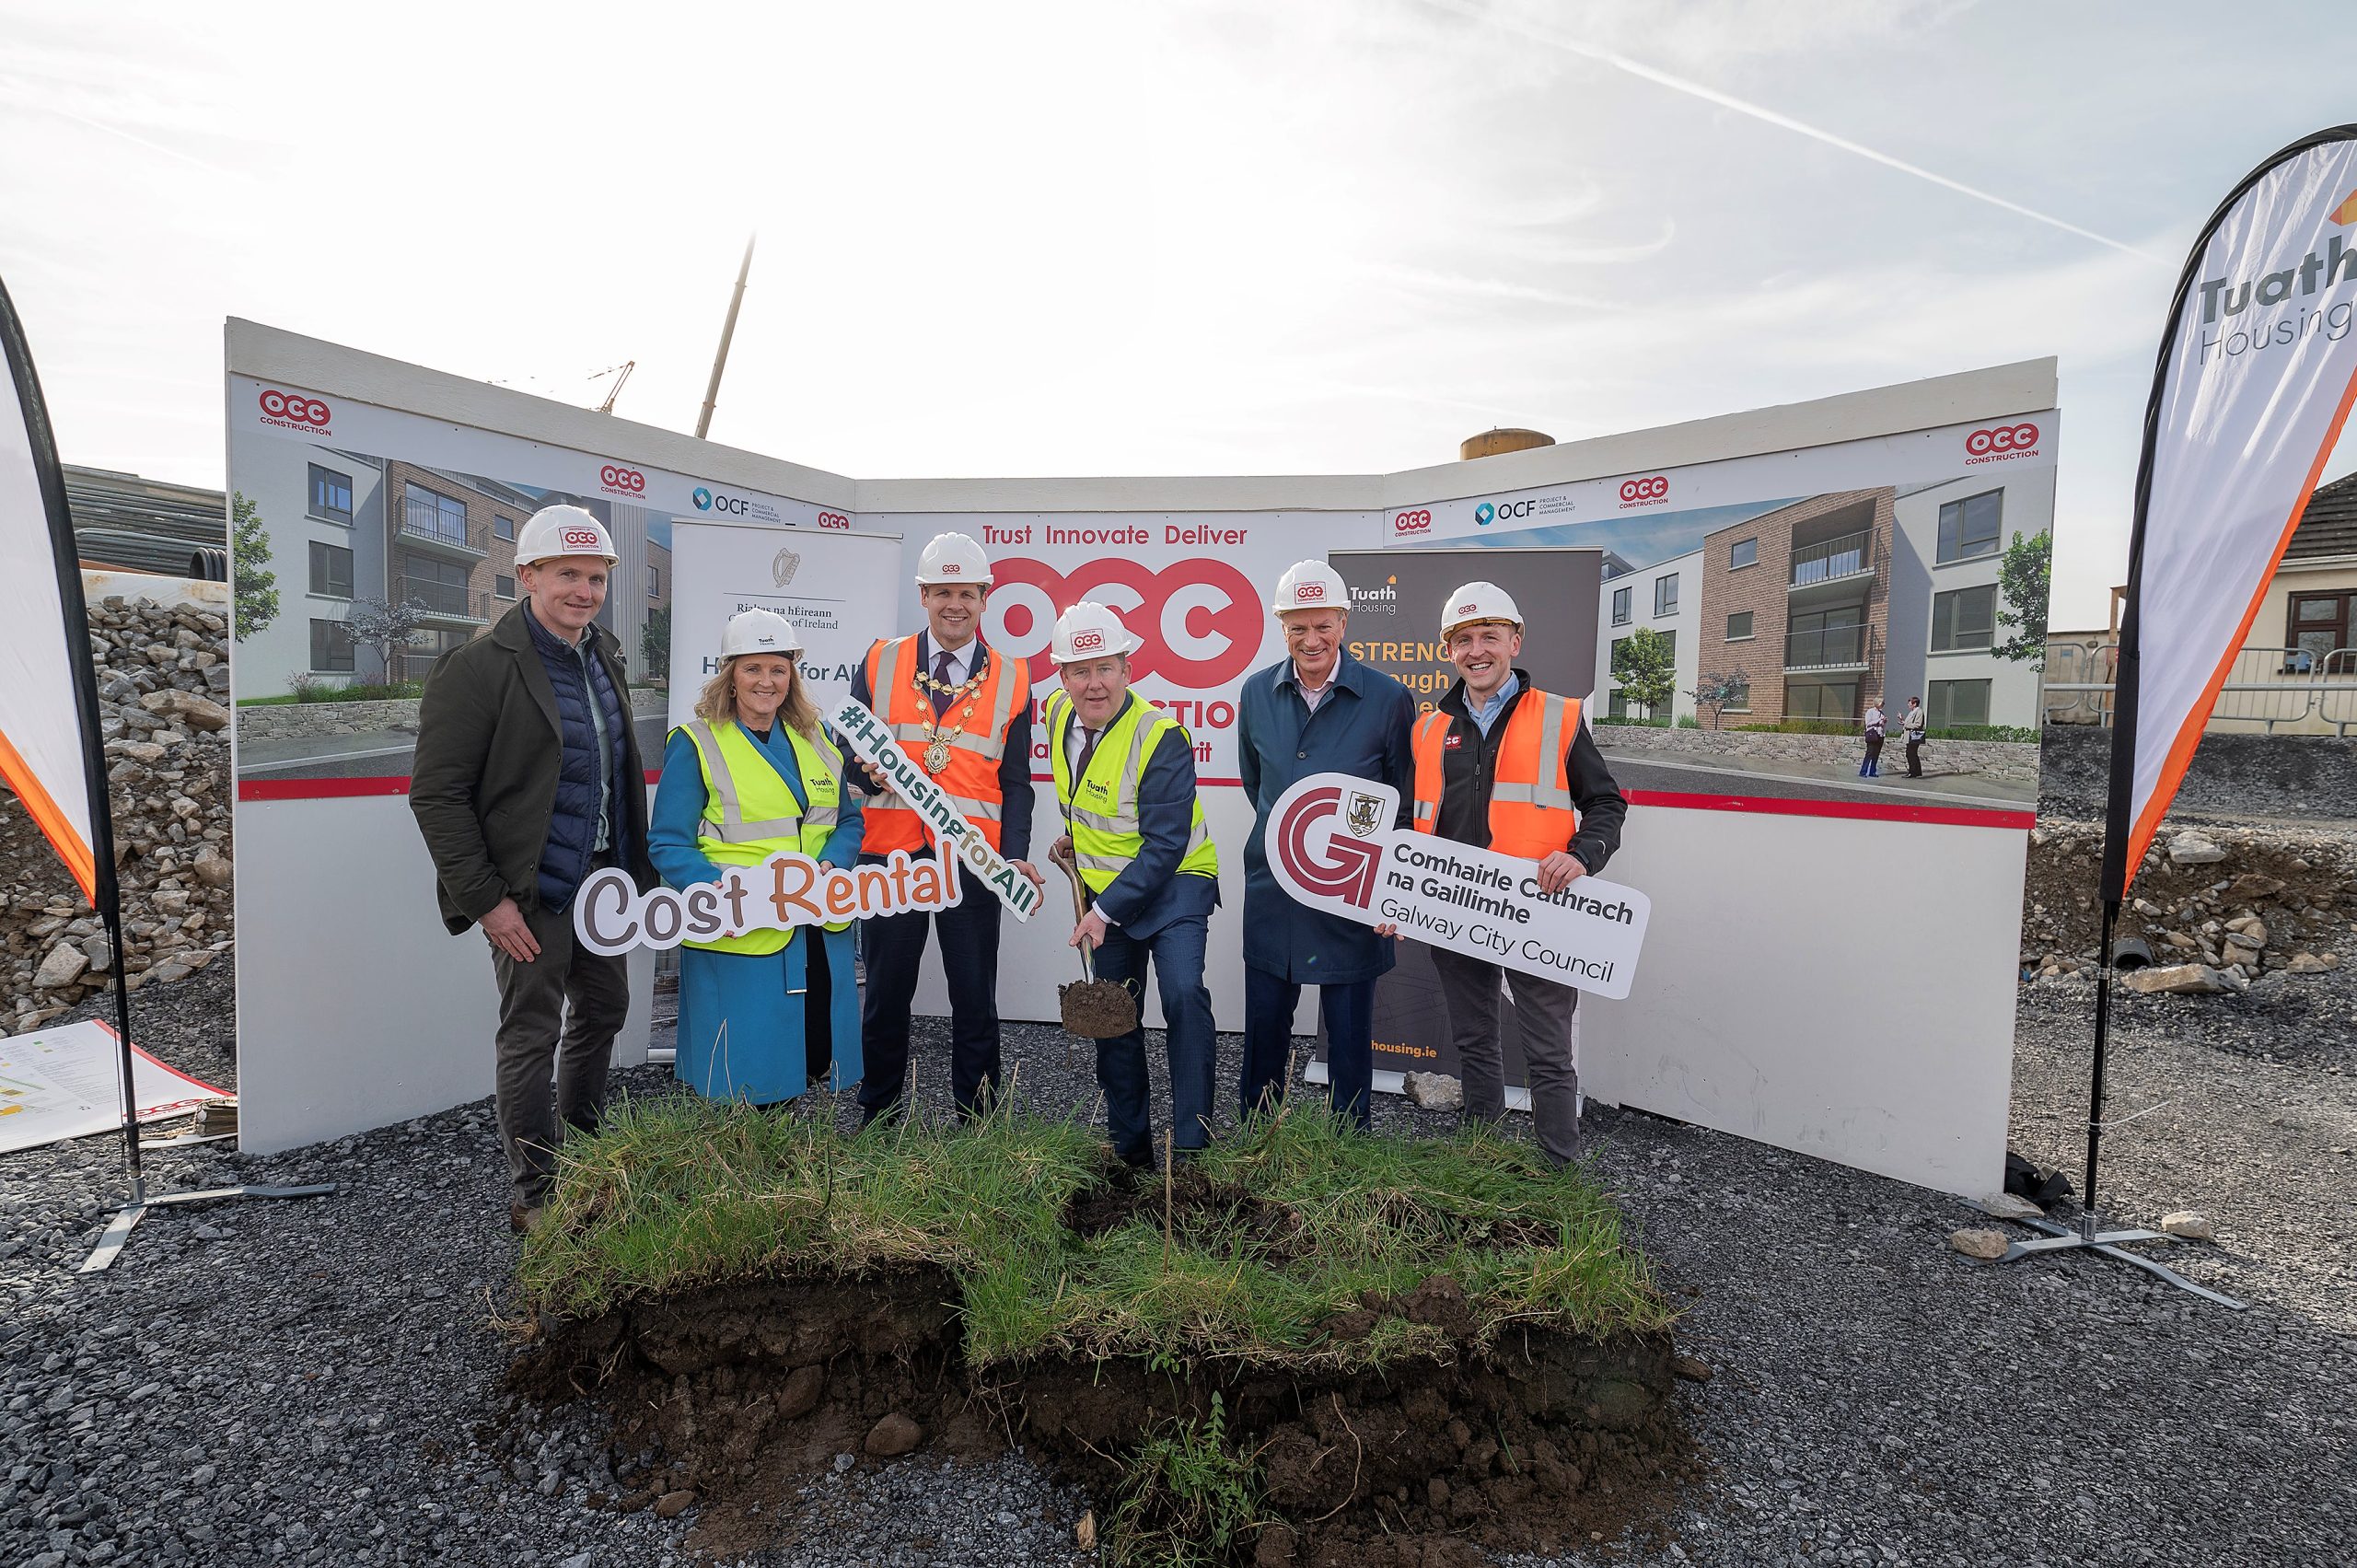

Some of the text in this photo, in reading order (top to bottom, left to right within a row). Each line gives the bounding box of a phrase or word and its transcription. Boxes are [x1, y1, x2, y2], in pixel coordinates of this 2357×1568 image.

[2200, 235, 2357, 324] Tuath
[2200, 300, 2354, 366] Housing
[261, 391, 330, 425] OCC
[260, 416, 332, 436] CONSTRUCTION
[1967, 424, 2038, 455] OCC
[1965, 449, 2039, 465] CONSTRUCTION
[601, 466, 644, 491] OCC
[600, 486, 646, 500] CONSTRUCTION
[1620, 477, 1667, 500] OCC
[714, 495, 749, 516] OCF
[751, 502, 771, 511] PROJECT
[751, 507, 780, 518] COMMERCIAL
[1498, 499, 1536, 519] OCF
[1538, 501, 1574, 509] COMMERCIAL
[1538, 505, 1576, 515] MANAGEMENT
[1619, 498, 1668, 509] CONSTRUCTION
[751, 514, 781, 523] MANAGEMENT
[1396, 510, 1431, 528] OCC
[981, 525, 1248, 545] Trust Innovate Deliver
[1395, 528, 1432, 538] CONSTRUCTION
[1298, 587, 1323, 598] OCC
[1350, 586, 1397, 600] Tuath
[773, 607, 785, 615] na
[787, 606, 832, 618] hÉireann
[1352, 601, 1396, 616] Housing
[1458, 604, 1477, 614] OCC
[792, 618, 804, 627] of
[805, 620, 839, 630] Ireland
[1074, 634, 1101, 647] OCC
[1349, 642, 1451, 662] STRENG
[799, 662, 861, 682] for Al
[1086, 779, 1109, 796] Tuath
[1394, 843, 1633, 925] Comhairle Cathrach
[584, 841, 957, 947] Cost Rental
[1386, 870, 1531, 924] na Gaillimhe
[1380, 898, 1614, 982] Galway City Council
[1371, 1040, 1437, 1058] housing.ie
